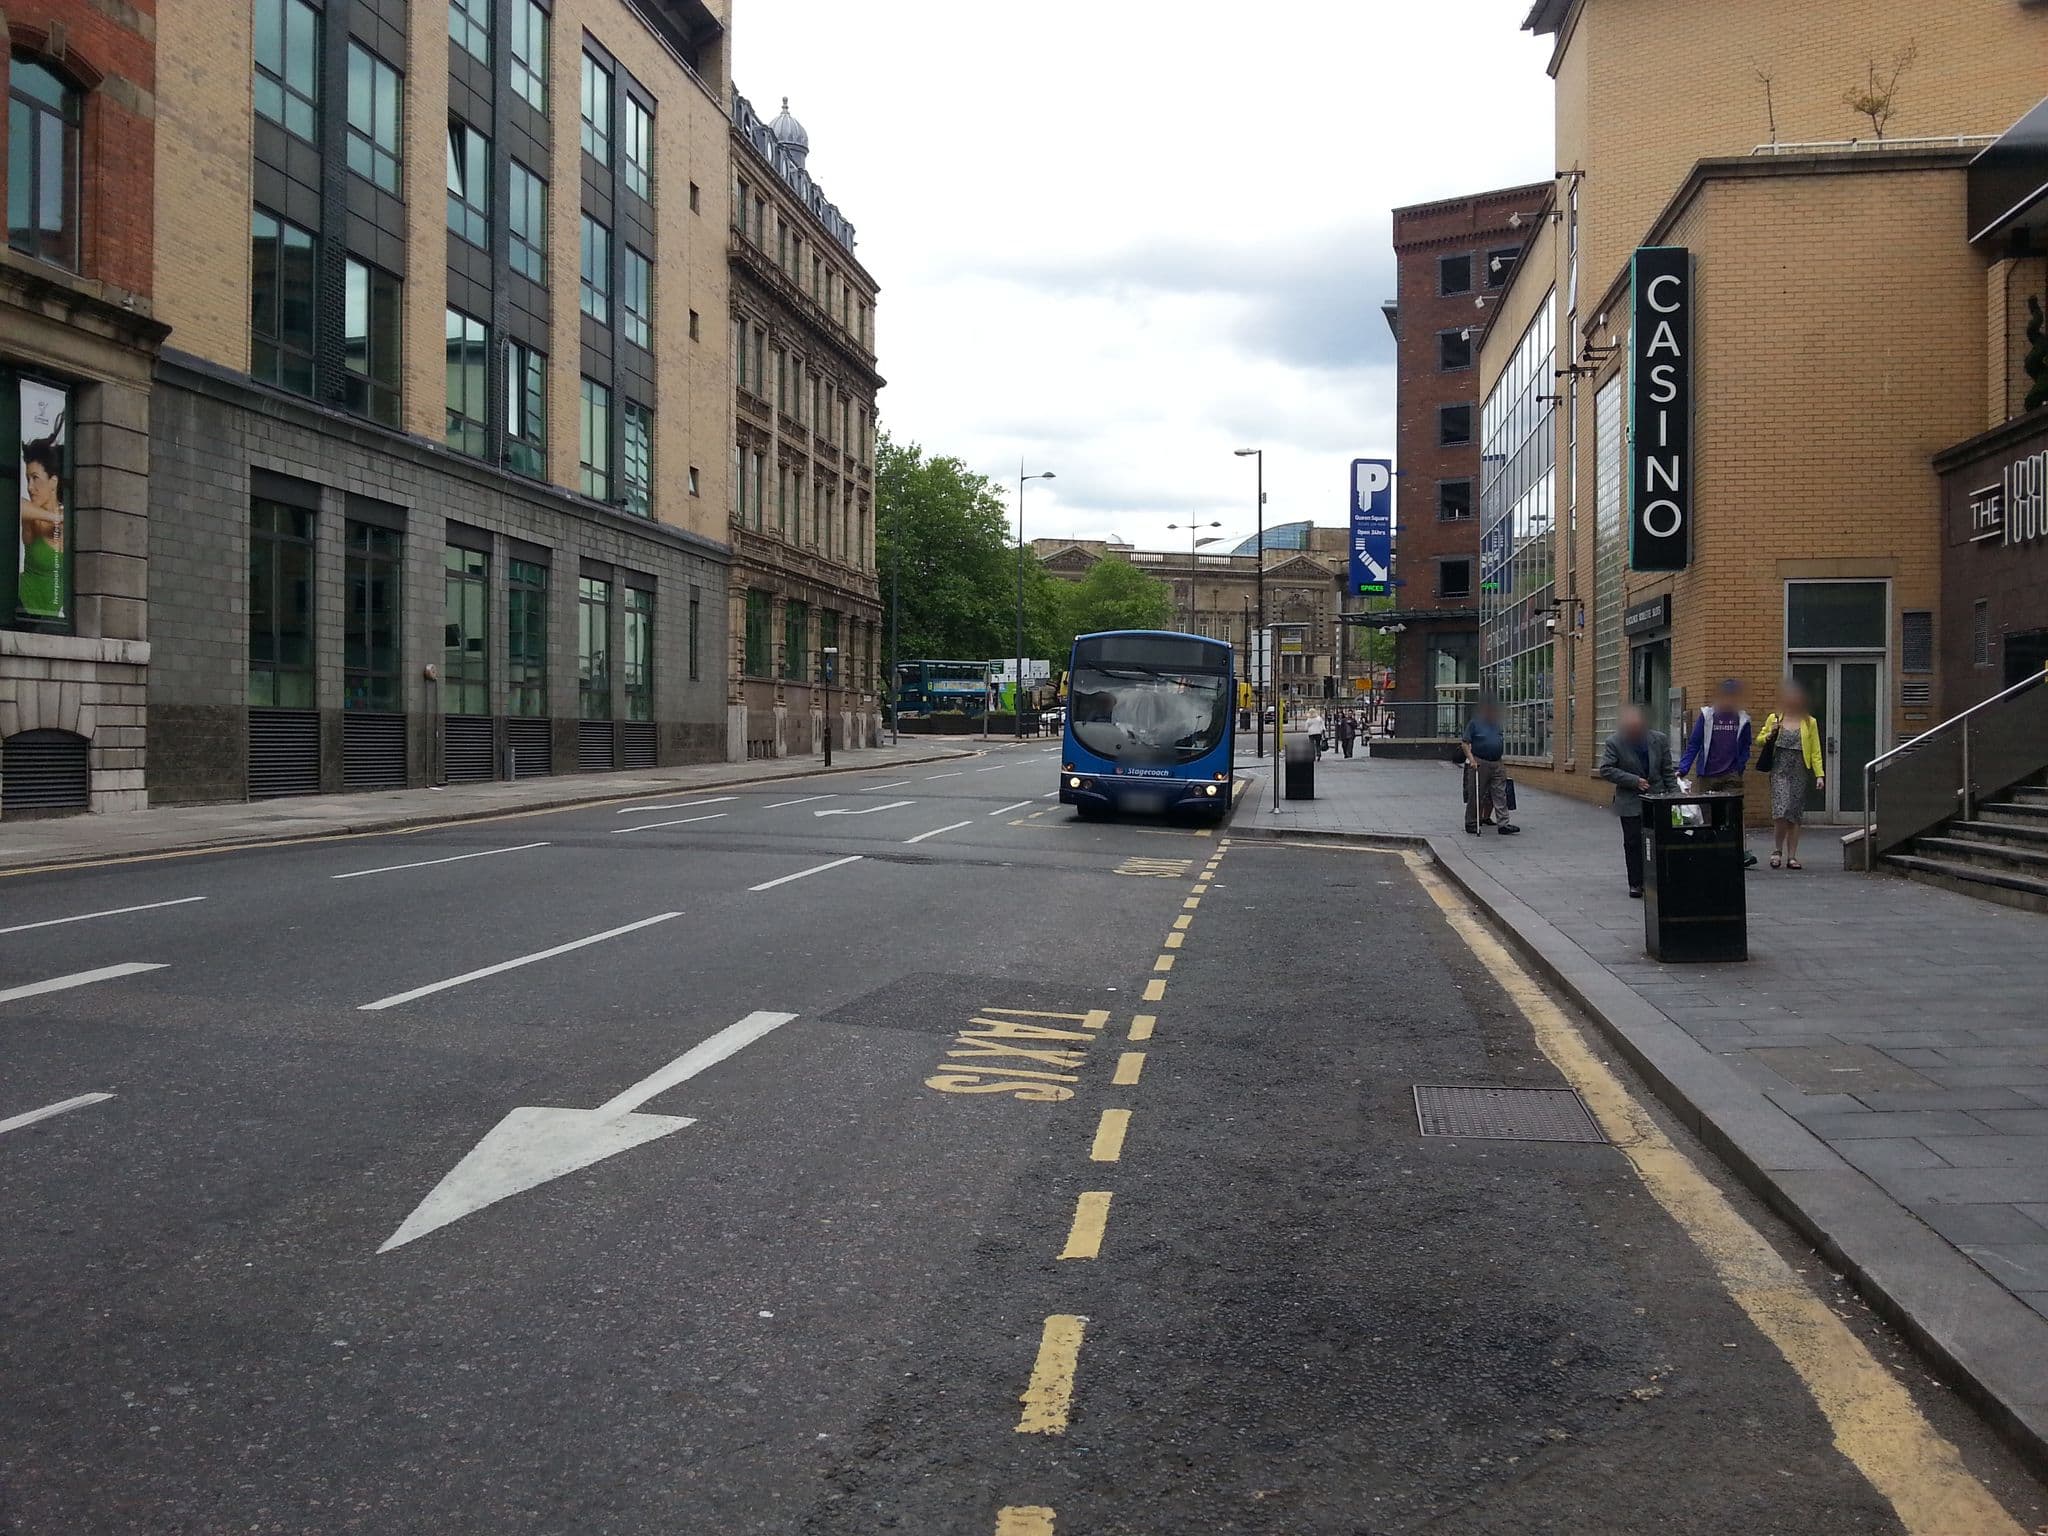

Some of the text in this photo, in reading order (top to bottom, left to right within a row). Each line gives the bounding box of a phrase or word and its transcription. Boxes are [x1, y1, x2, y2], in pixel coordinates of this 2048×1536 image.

[1643, 274, 1682, 538] CASINO
[1357, 463, 1388, 512] P
[1371, 514, 1389, 523] Square
[1970, 495, 2000, 530] THE
[1357, 529, 1370, 537] Open
[1127, 767, 1169, 777] Stagecoach
[924, 1007, 1111, 1101] TAXIS
